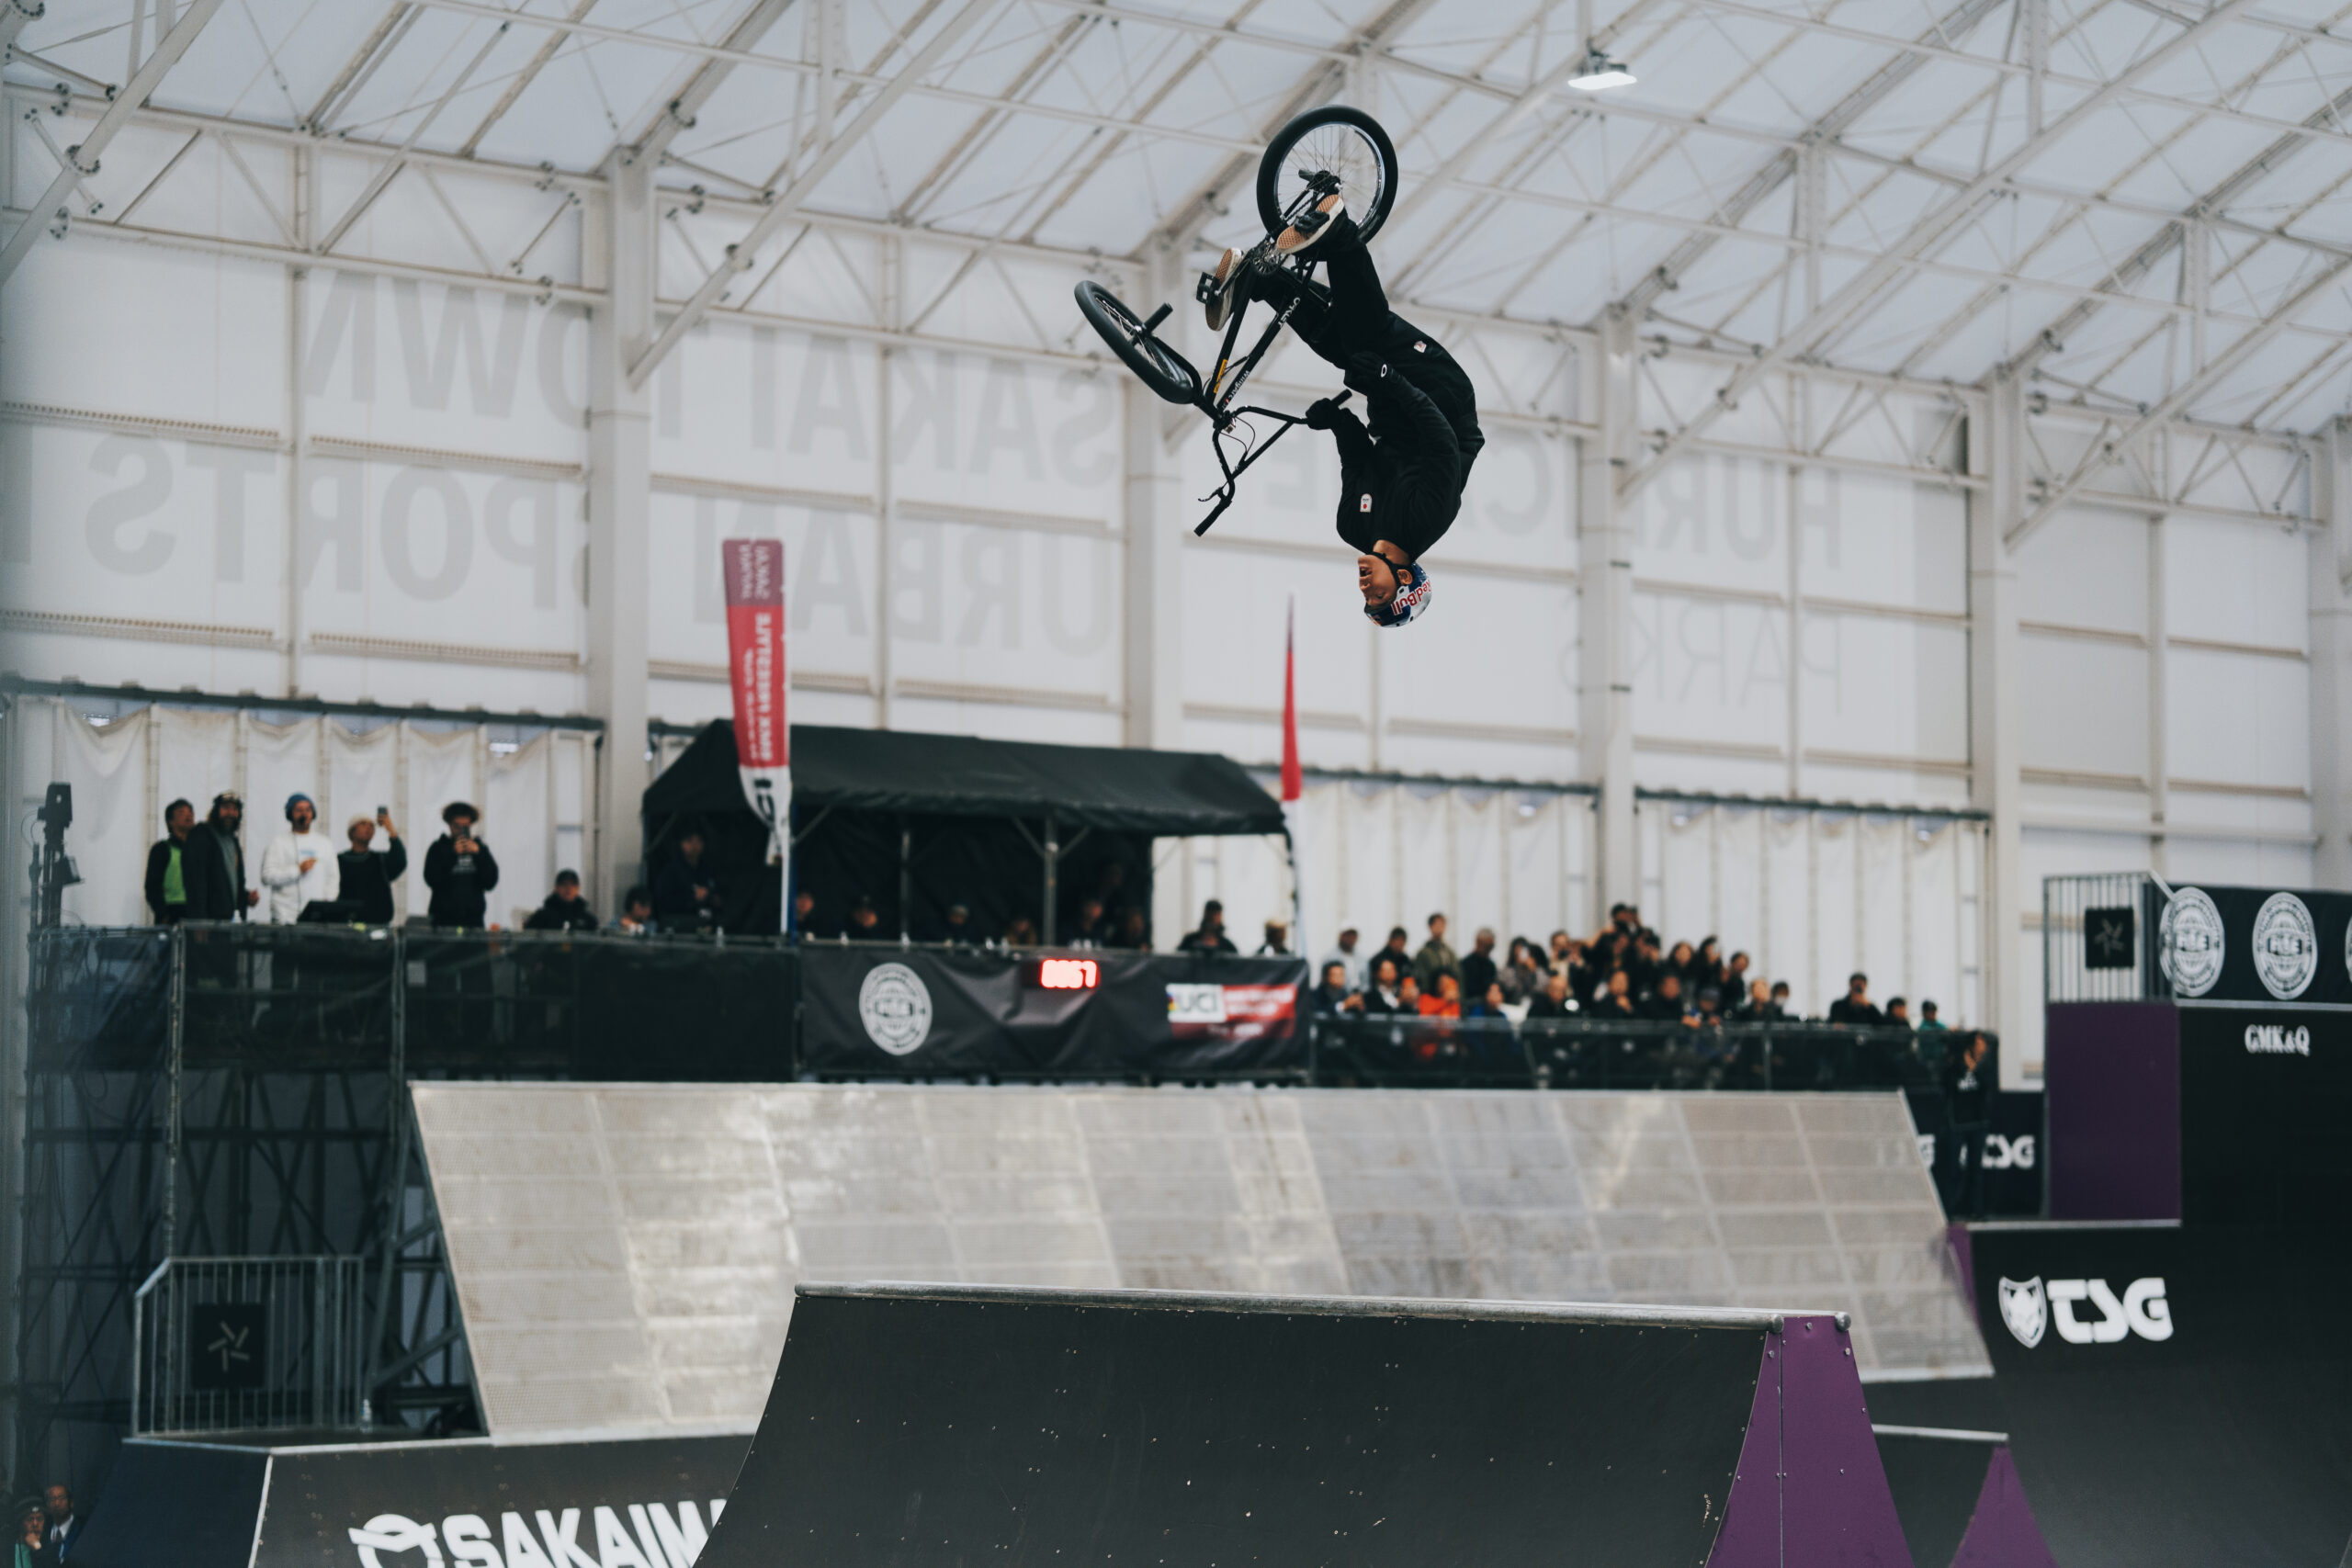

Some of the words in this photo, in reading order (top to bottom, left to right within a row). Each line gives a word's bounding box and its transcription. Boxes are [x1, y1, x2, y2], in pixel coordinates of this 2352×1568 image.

[1278, 297, 1301, 328] OAKLEY
[1390, 592, 1418, 615] Bull
[1415, 580, 1431, 602] Red
[2245, 1024, 2310, 1056] GMK&Q
[2046, 1277, 2174, 1344] TSG
